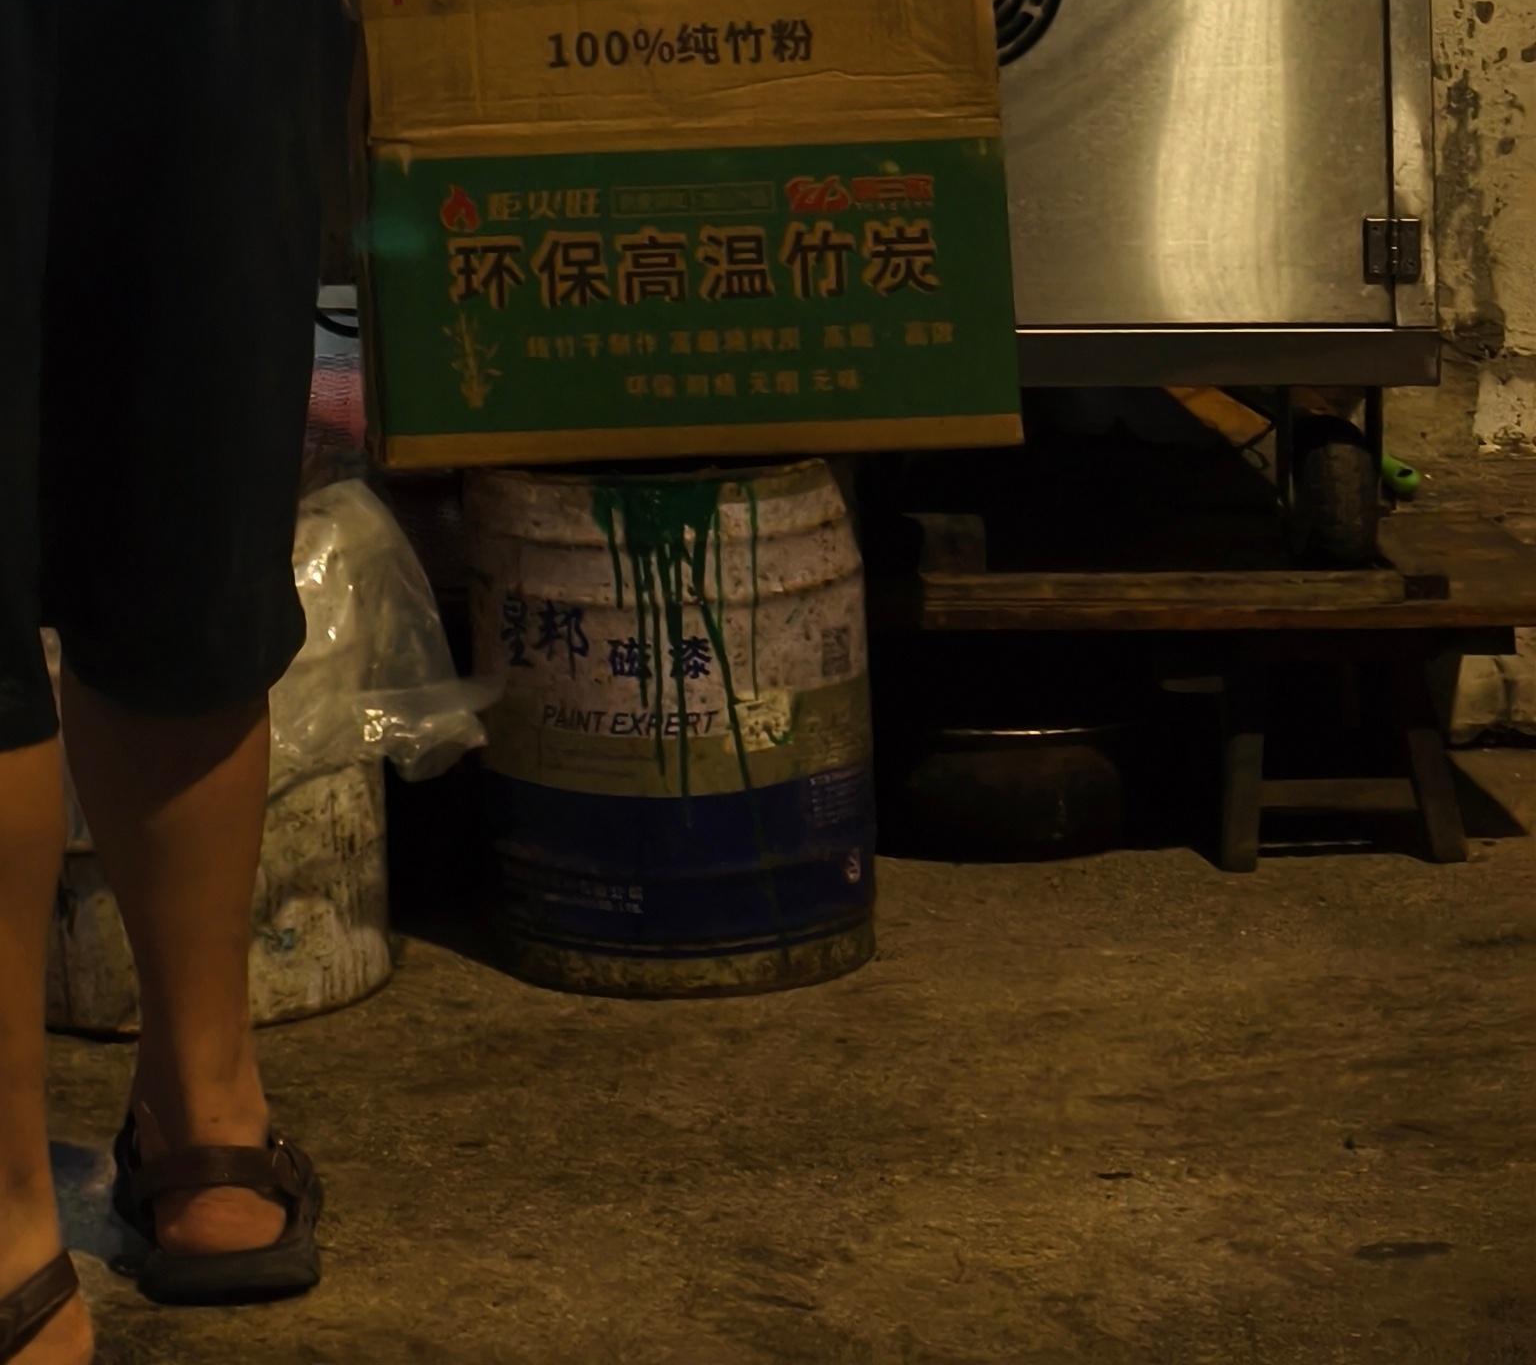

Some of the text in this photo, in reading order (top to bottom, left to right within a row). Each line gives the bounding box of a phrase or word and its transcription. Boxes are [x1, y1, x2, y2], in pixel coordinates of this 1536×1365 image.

[547, 19, 814, 68] 100%纯竹粉
[449, 219, 940, 309] 环保高温竹炭
[543, 704, 604, 735] PAINT
